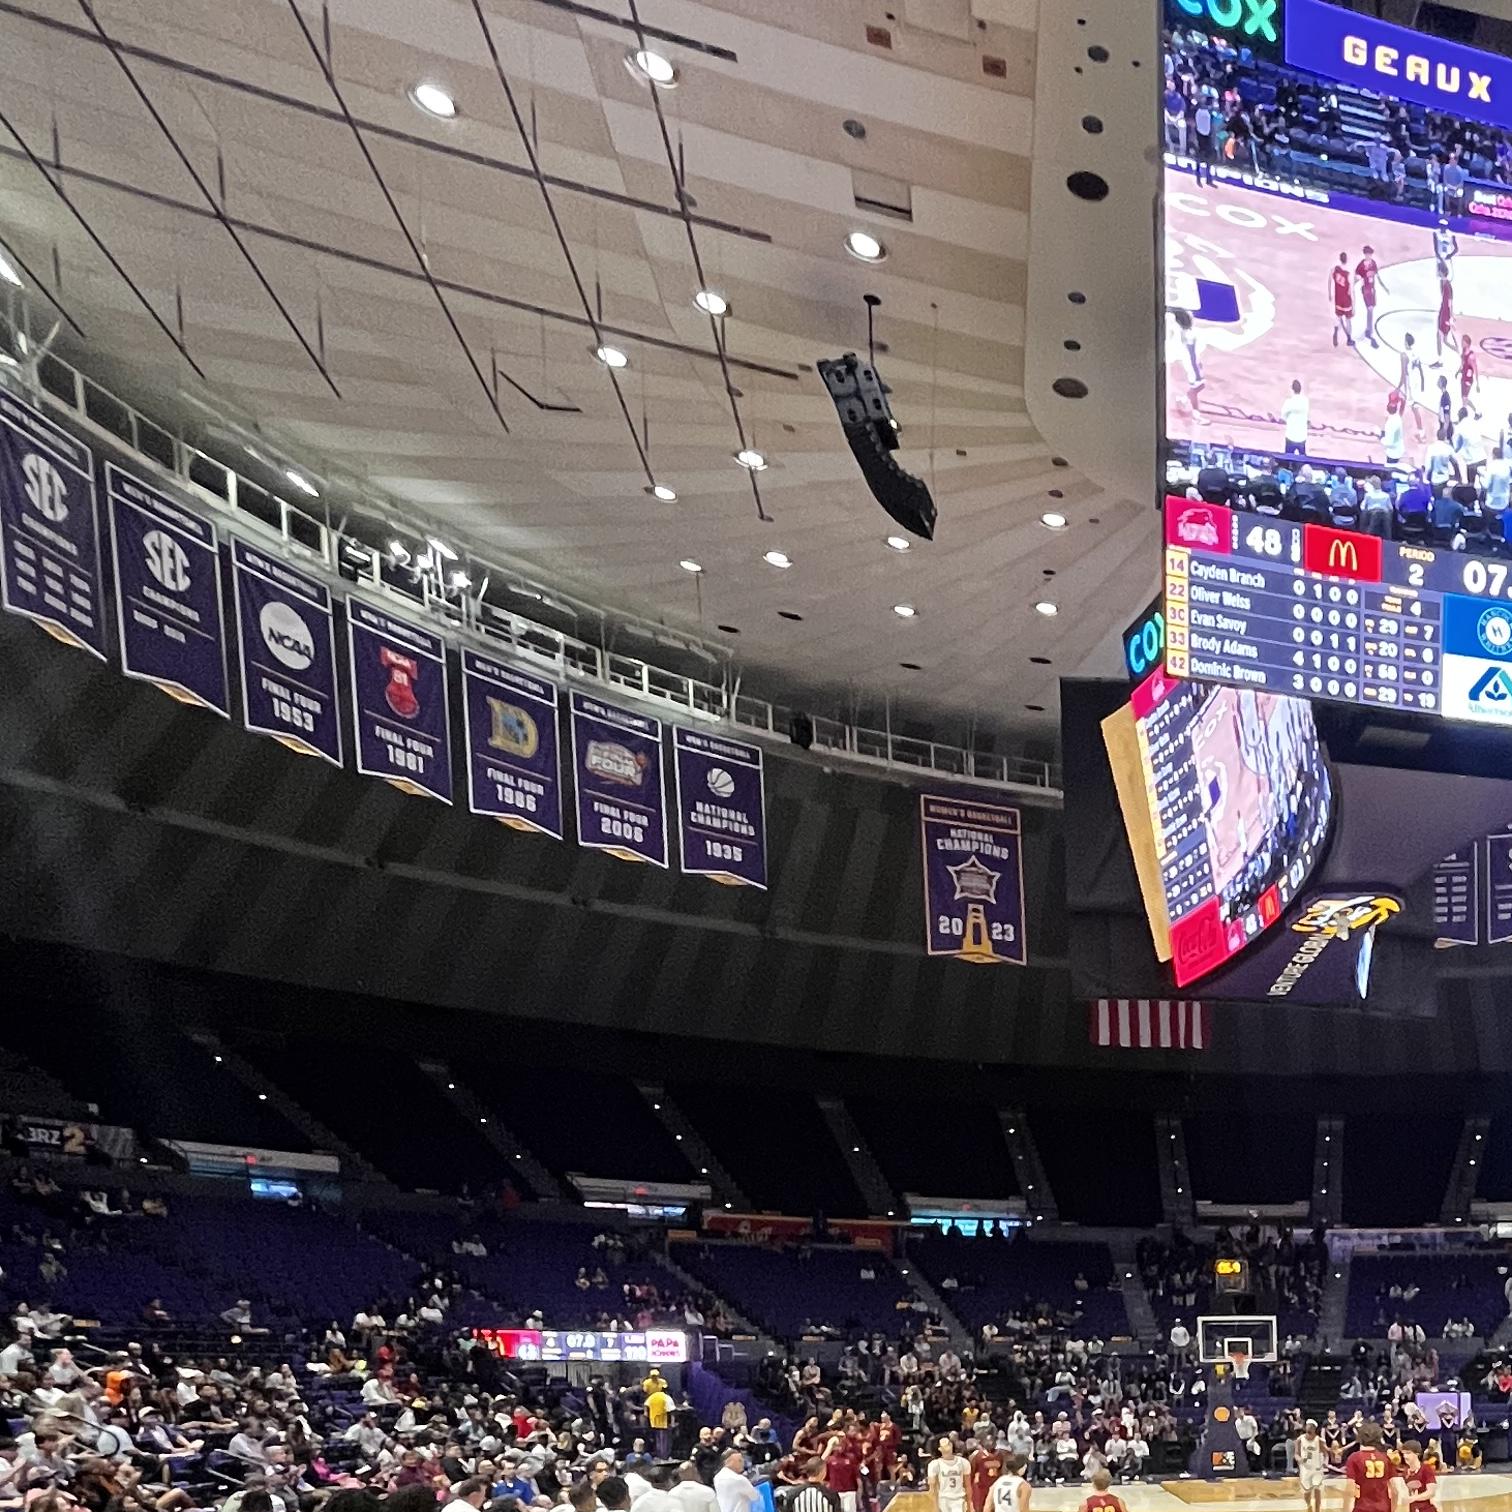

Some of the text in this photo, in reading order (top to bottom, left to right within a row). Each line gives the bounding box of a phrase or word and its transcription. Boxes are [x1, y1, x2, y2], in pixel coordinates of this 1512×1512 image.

[1343, 35, 1492, 102] GEAUX
[1246, 525, 1282, 555] 48
[143, 530, 192, 592] SEC
[1170, 559, 1184, 571] 14
[1408, 563, 1424, 586] 2
[1169, 583, 1185, 596] 22
[268, 626, 314, 661] NCAA
[1170, 631, 1185, 645] 33
[1170, 657, 1185, 669] 42
[1233, 664, 1266, 684] Brown
[950, 828, 994, 844] NATIONAL
[936, 838, 1009, 861] CHAMPIONS
[938, 915, 1015, 942] 20 23
[651, 1339, 679, 1348] PAPA
[949, 1478, 956, 1489] 3
[997, 1488, 1012, 1506] 14
